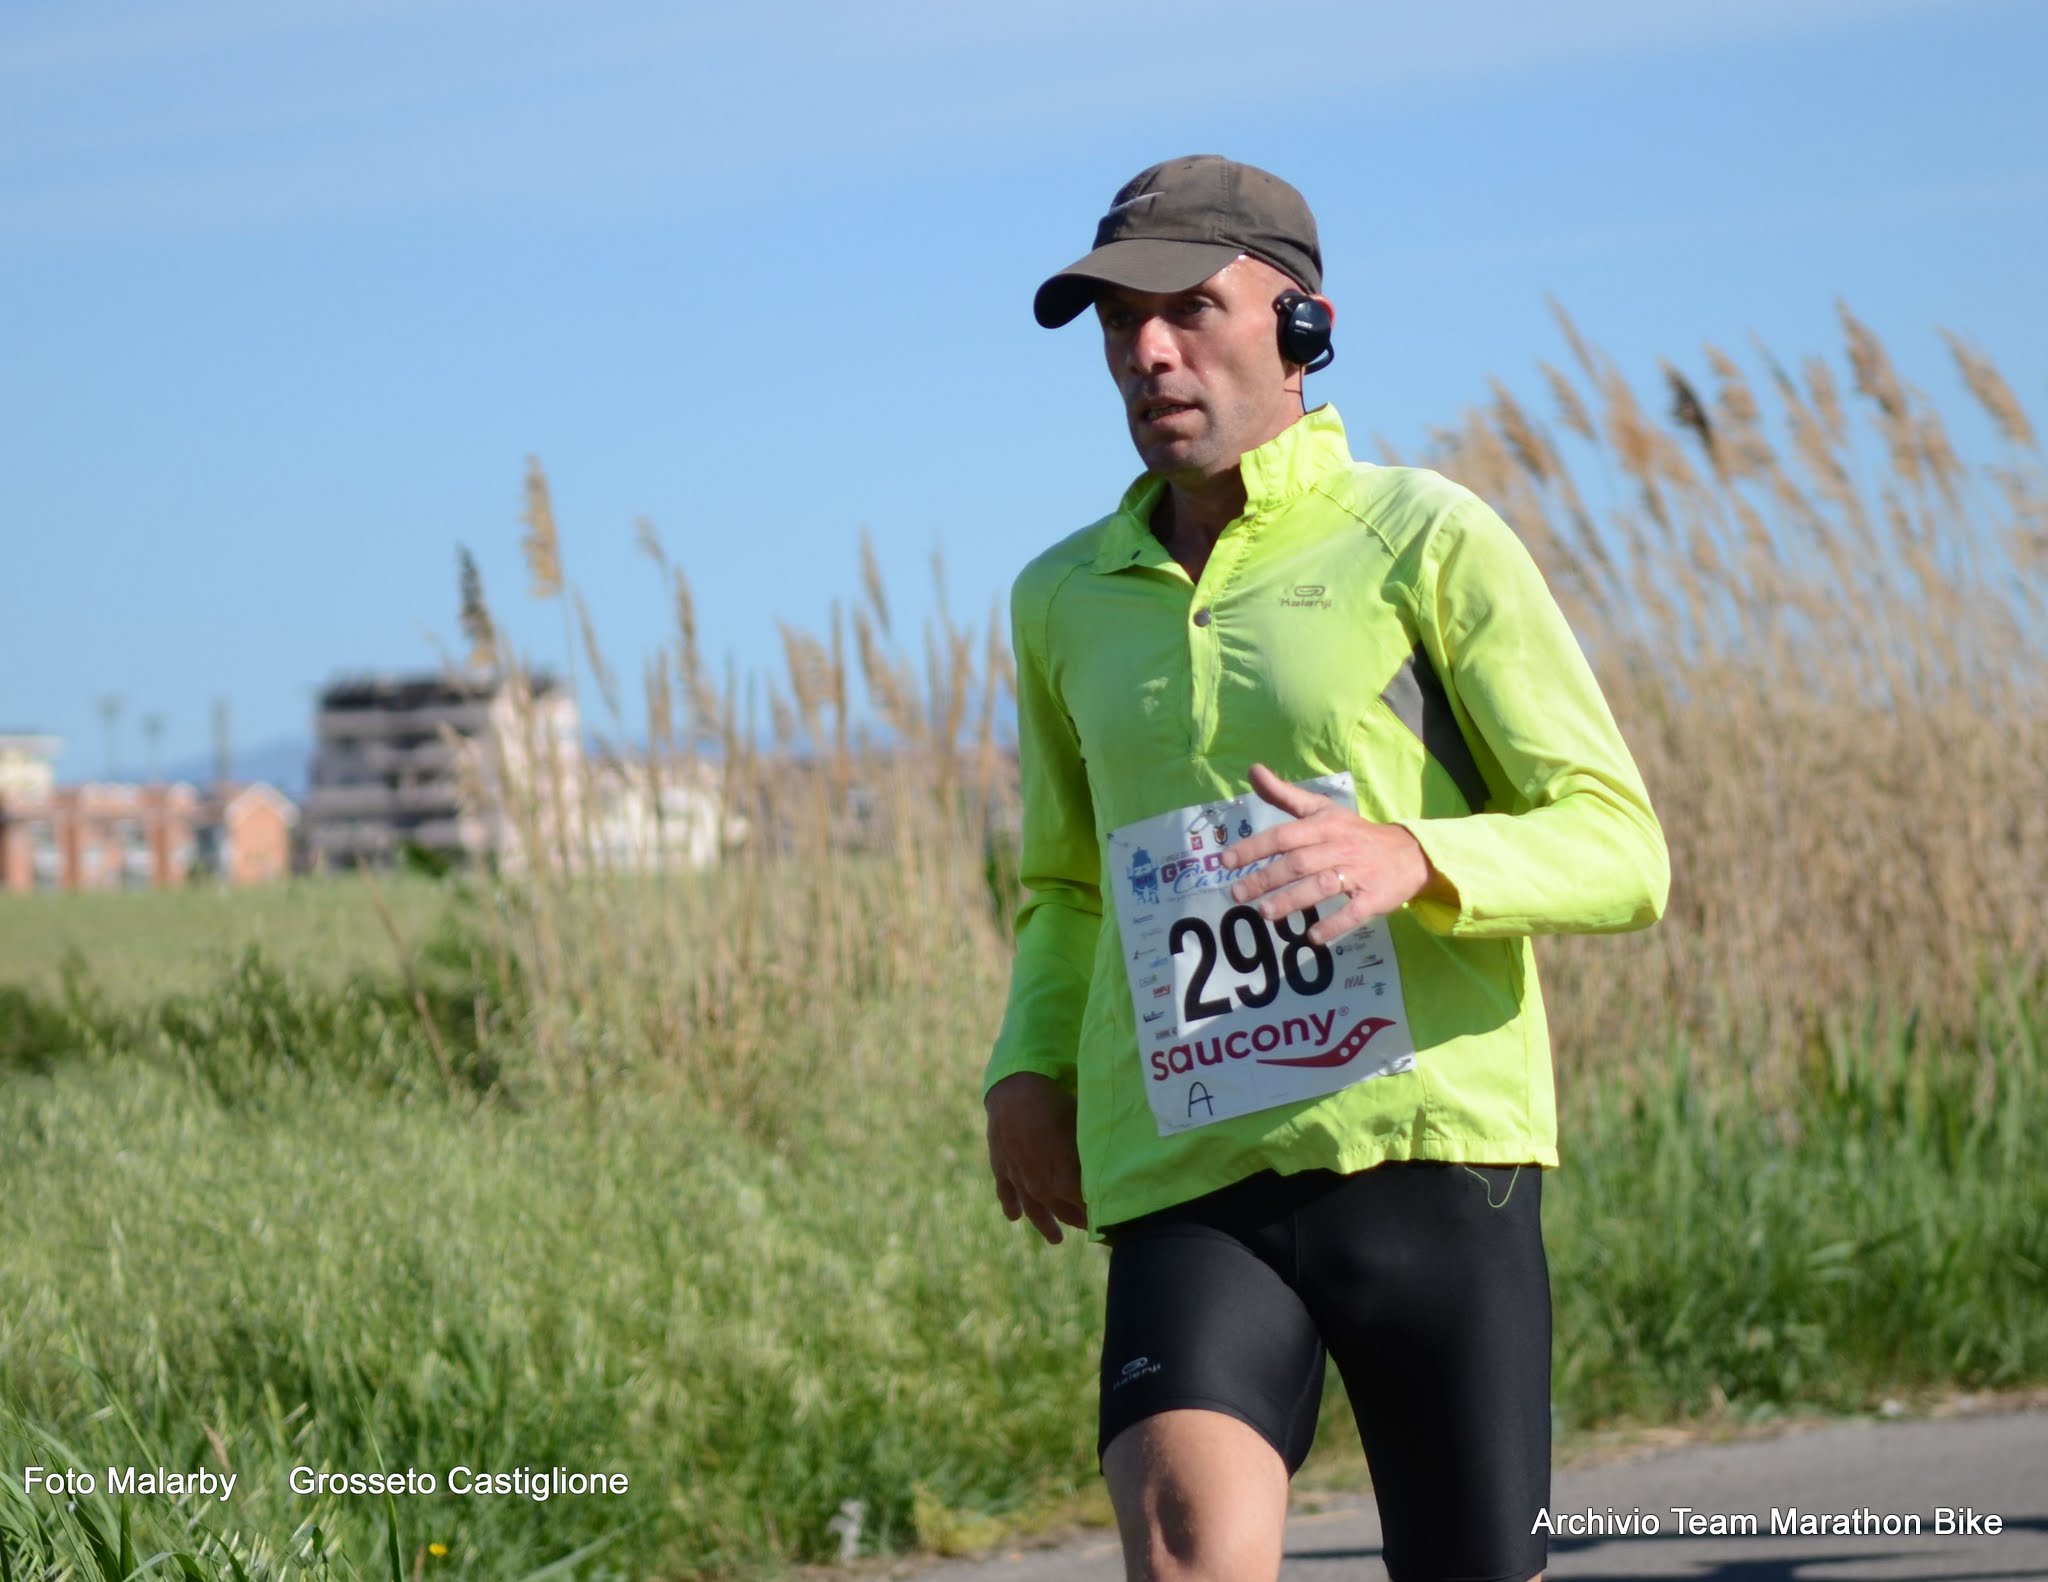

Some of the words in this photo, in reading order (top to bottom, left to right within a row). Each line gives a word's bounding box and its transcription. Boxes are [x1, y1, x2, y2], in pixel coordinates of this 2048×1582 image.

[1168, 904, 1335, 1023] 298
[1151, 1009, 1336, 1081] saucony
[1187, 1081, 1214, 1118] A
